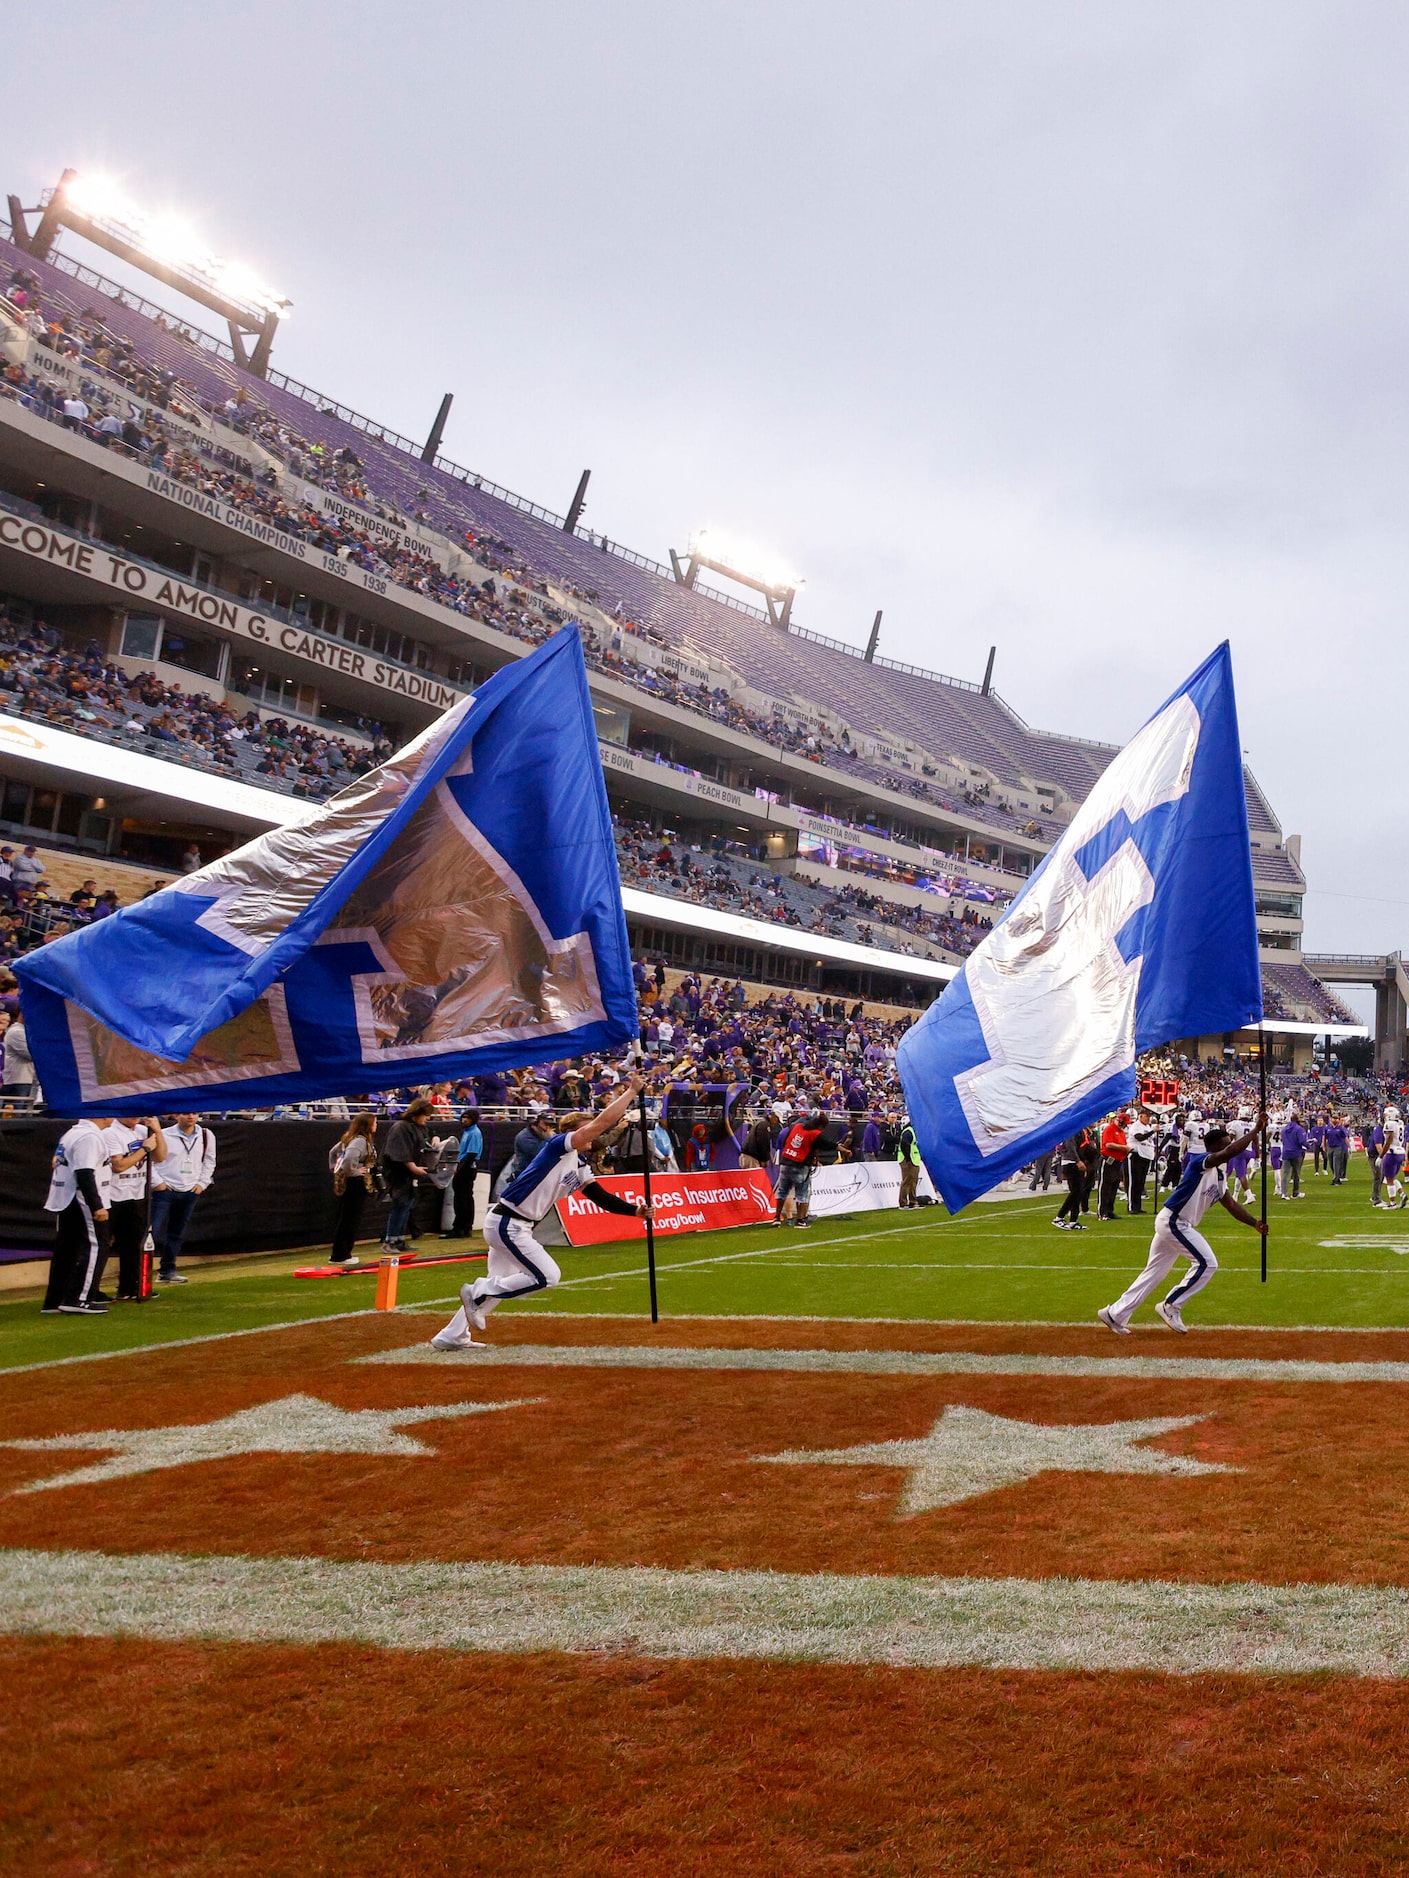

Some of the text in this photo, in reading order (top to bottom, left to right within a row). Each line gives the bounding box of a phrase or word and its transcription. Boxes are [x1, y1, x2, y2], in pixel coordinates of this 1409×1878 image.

[33, 351, 73, 381] HOME
[147, 472, 387, 595] NATIONAL CHAMPIONS 1935 1938
[323, 497, 433, 560] INDEPENDENCE BOWL
[108, 555, 147, 591] TO
[155, 579, 239, 629] AMON
[247, 614, 271, 642] G.
[279, 627, 366, 678] CARTER
[372, 662, 457, 708] STADIUM
[661, 653, 711, 684] LIBERTY BOWL
[772, 701, 787, 714] FORT
[787, 706, 809, 724] WORTH
[611, 752, 635, 771] BOWL
[876, 743, 909, 762] TEXAS BOWL
[697, 782, 742, 807] PEACH BOWL
[808, 818, 861, 844] POINSETTIA BOWL
[953, 864, 968, 876] BOWL
[623, 1188, 684, 1210] Foces
[683, 1186, 749, 1206] Insurance
